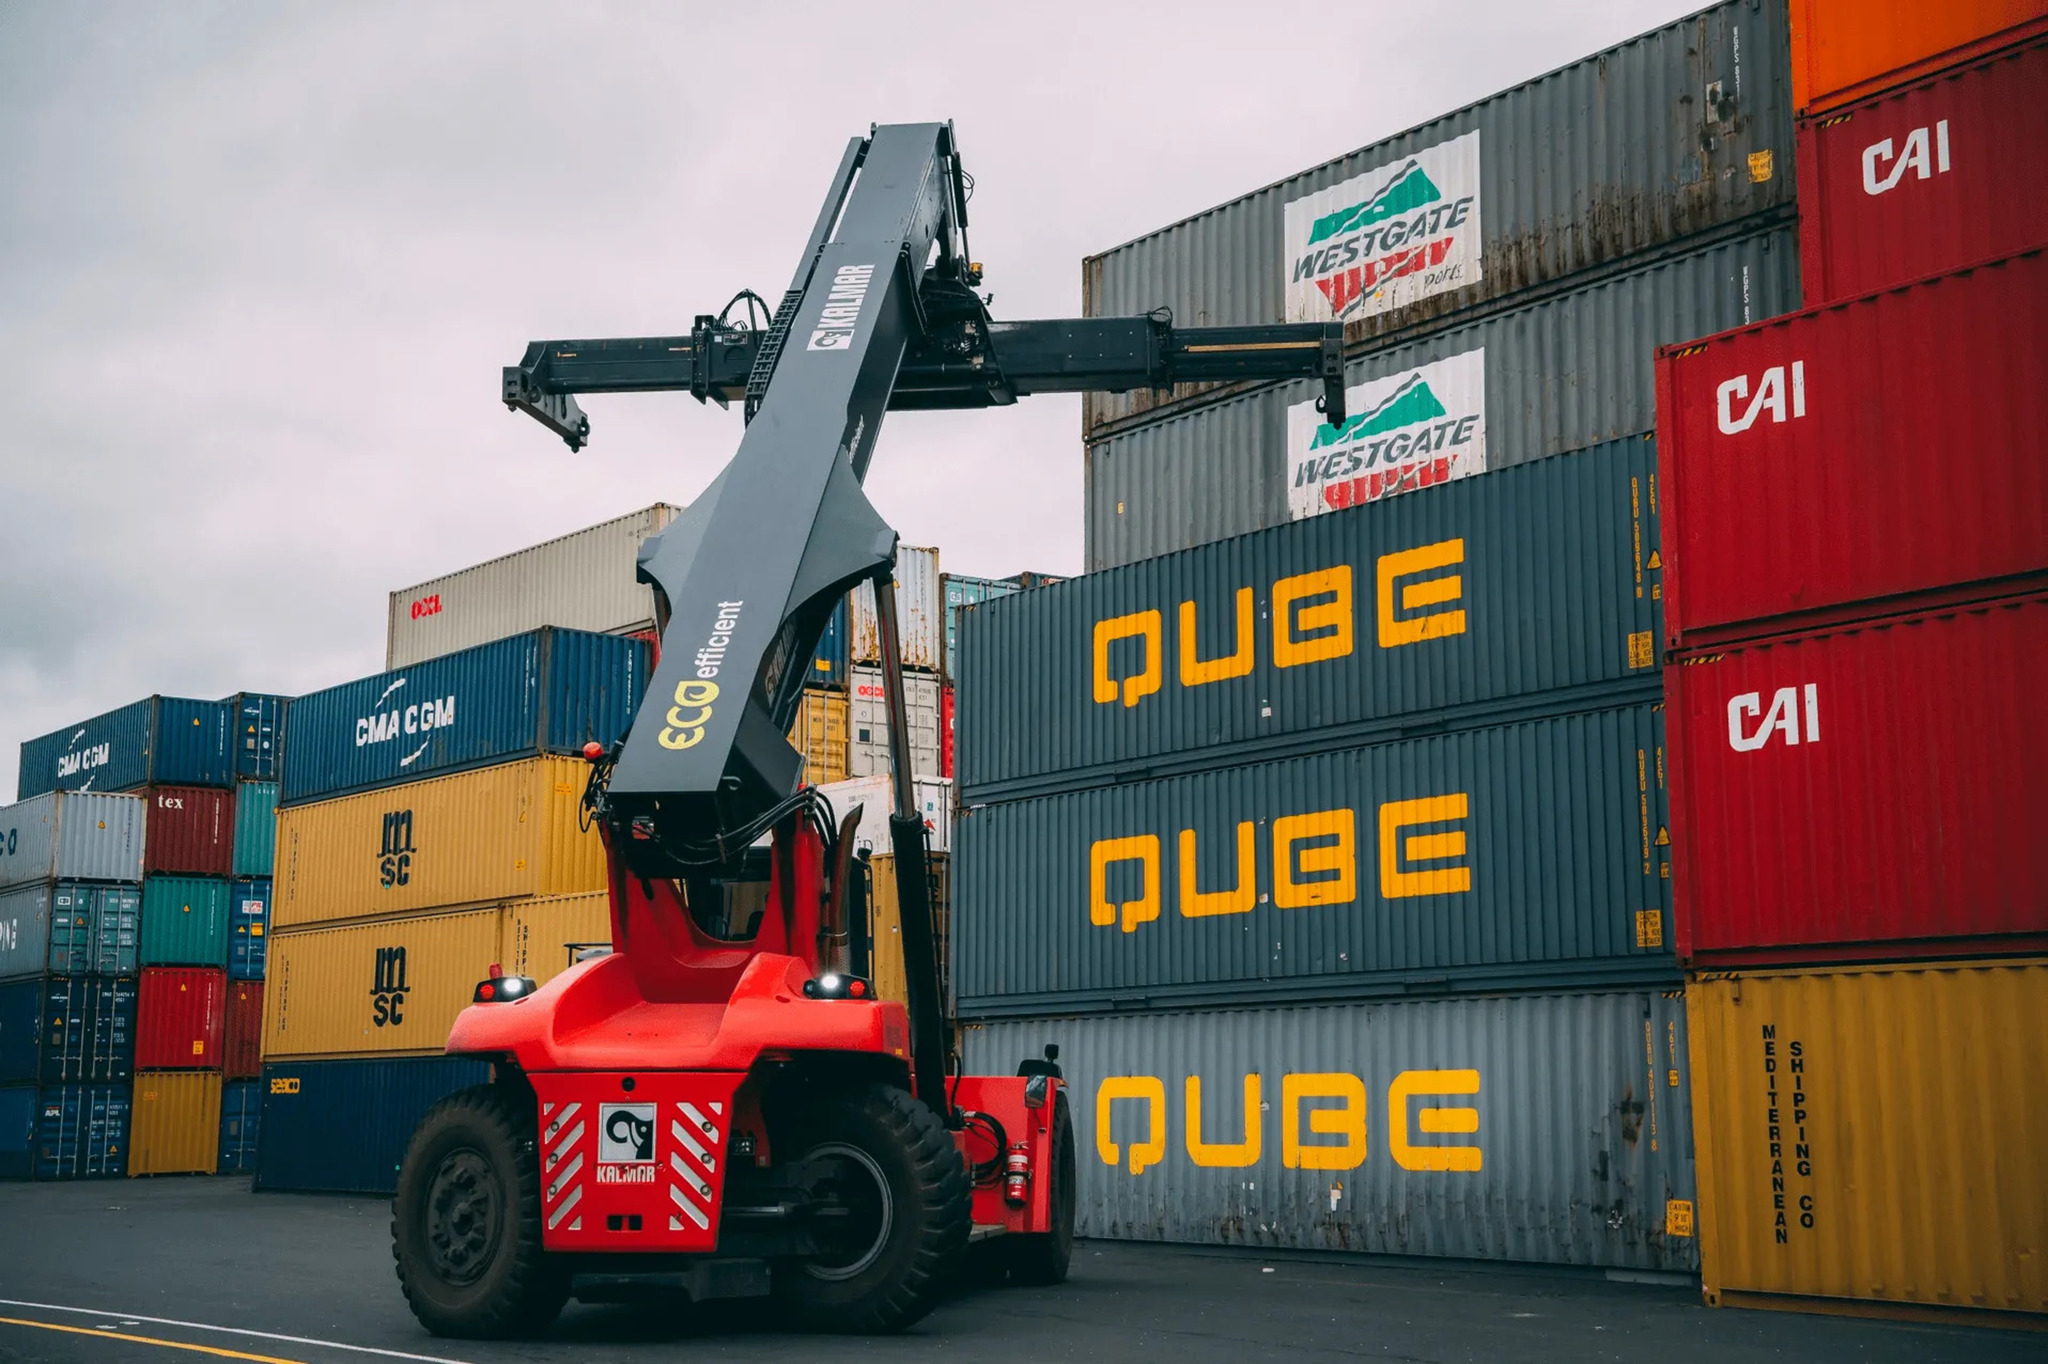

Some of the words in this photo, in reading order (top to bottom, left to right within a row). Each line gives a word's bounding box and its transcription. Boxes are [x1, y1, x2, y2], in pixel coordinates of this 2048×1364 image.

[1862, 119, 1951, 196] CAI
[1293, 195, 1475, 284] WESTGATE
[817, 264, 876, 329] KALMAR
[1716, 360, 1806, 435] CAI
[1295, 404, 1480, 488] WESTGATE
[1093, 538, 1467, 708] QUBE
[356, 709, 400, 748] CMA
[404, 695, 456, 735] CGM
[1727, 683, 1820, 753] CAI
[58, 751, 81, 778] CMA
[82, 742, 110, 770] CGM
[158, 795, 184, 809] tex
[1091, 792, 1471, 933] QUBE
[1095, 1068, 1483, 1176] QUBE
[1761, 1024, 1788, 1244] MEDITERRANEAN
[1789, 1041, 1812, 1177] SHIPPING
[597, 1165, 656, 1183] KALMAR
[1799, 1194, 1815, 1230] CO
